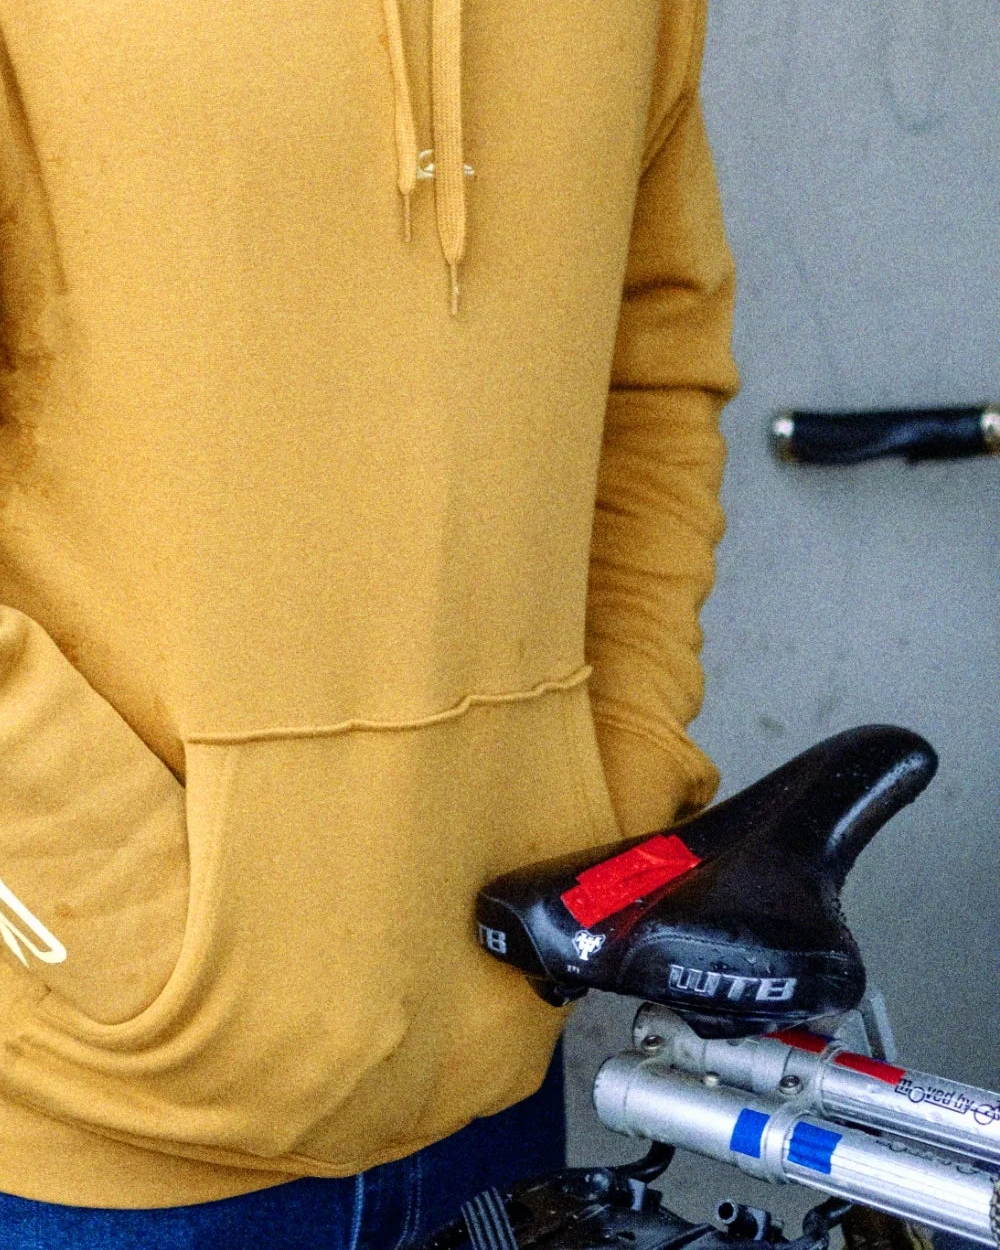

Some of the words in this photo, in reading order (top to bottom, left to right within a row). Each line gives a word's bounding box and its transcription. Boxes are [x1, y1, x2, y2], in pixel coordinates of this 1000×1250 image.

[477, 921, 506, 954] TB
[668, 963, 797, 1001] WTB
[898, 1077, 956, 1105] moved
[954, 1093, 975, 1114] by
